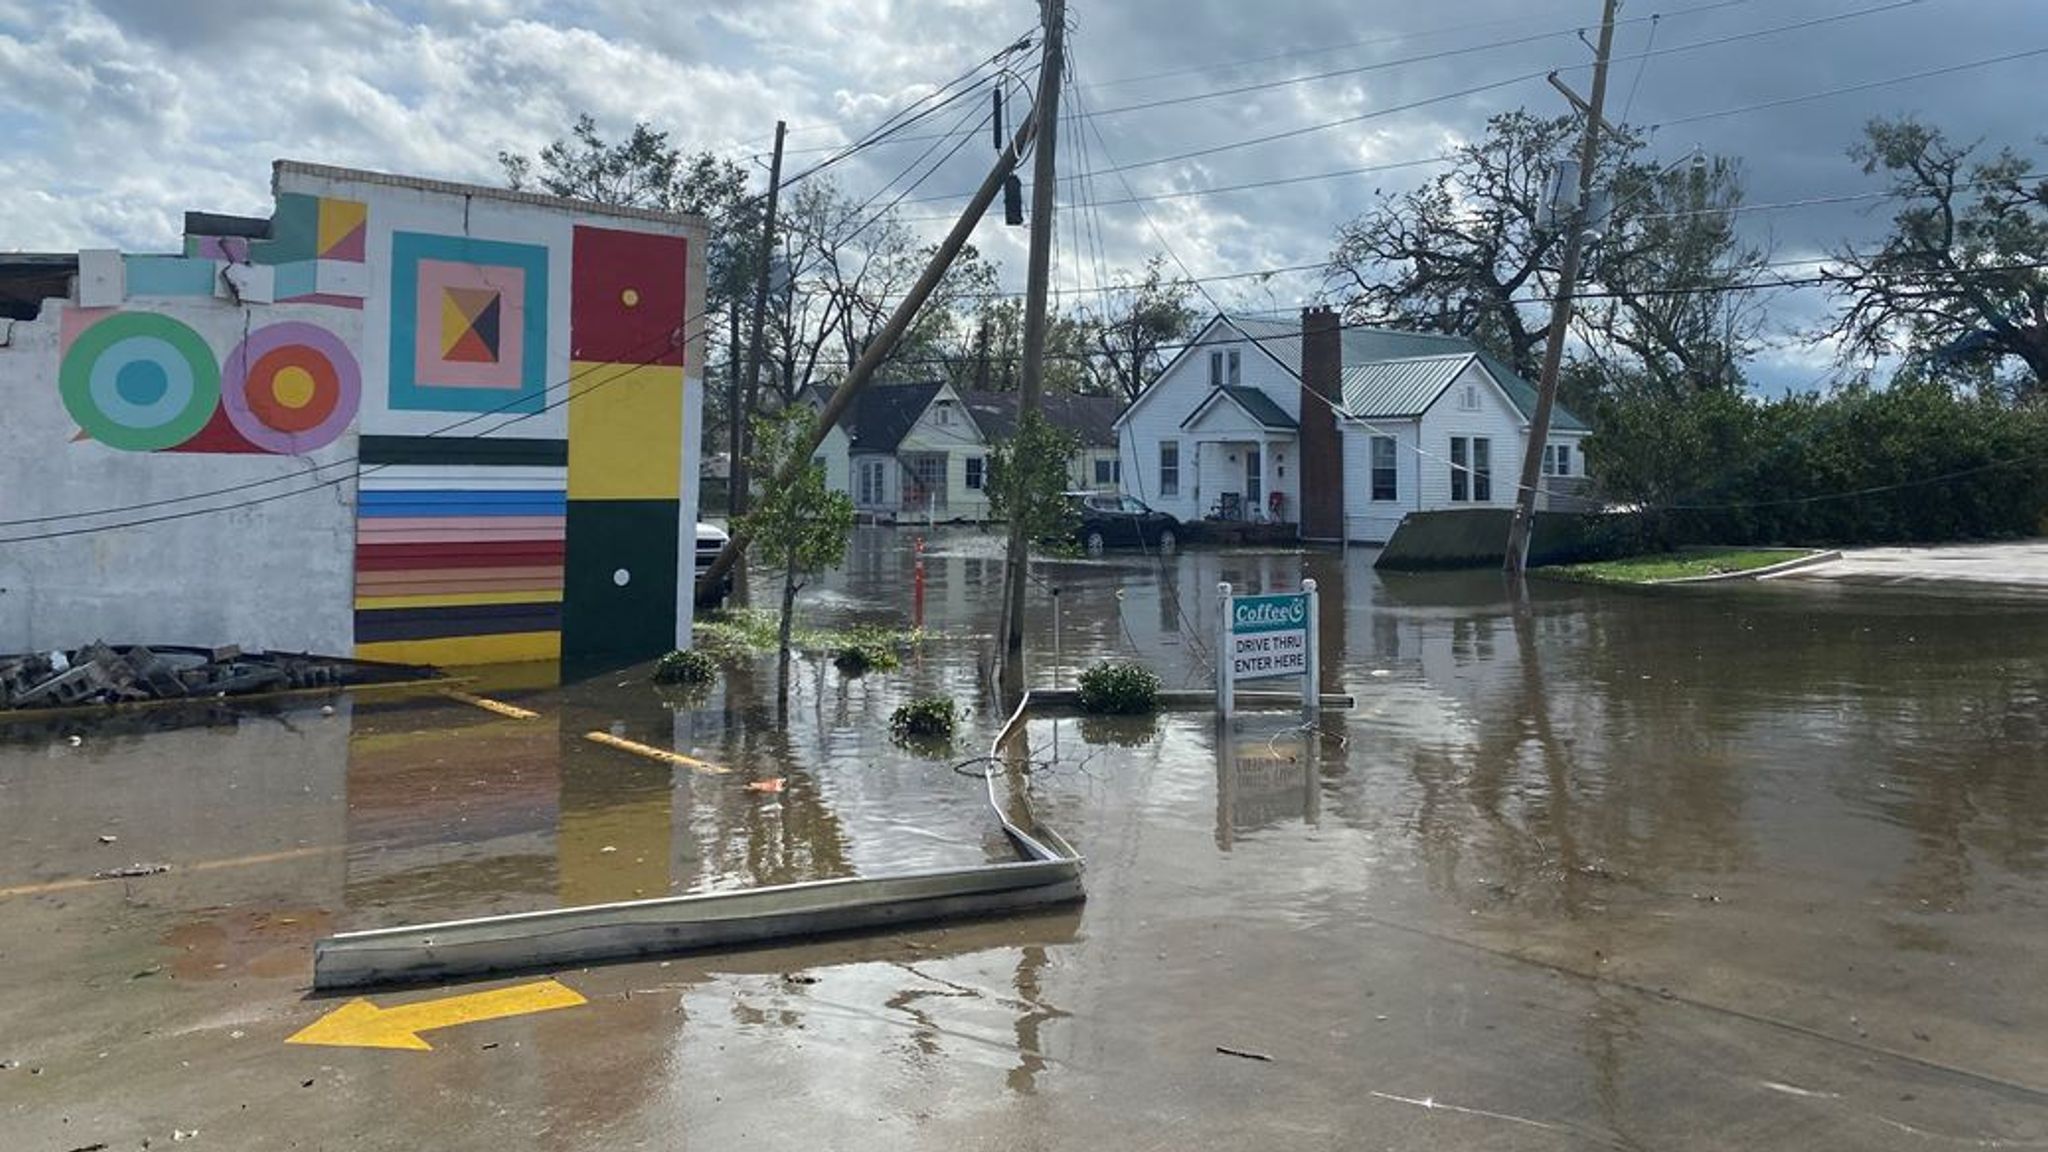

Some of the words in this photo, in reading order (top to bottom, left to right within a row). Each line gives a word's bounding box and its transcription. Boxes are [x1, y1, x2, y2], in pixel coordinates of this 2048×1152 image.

[1236, 603, 1289, 621] Coffee
[1236, 638, 1270, 653] DRIVE
[1272, 636, 1302, 649] THRU
[1235, 657, 1272, 673] ENTER
[1274, 654, 1304, 668] HERE
